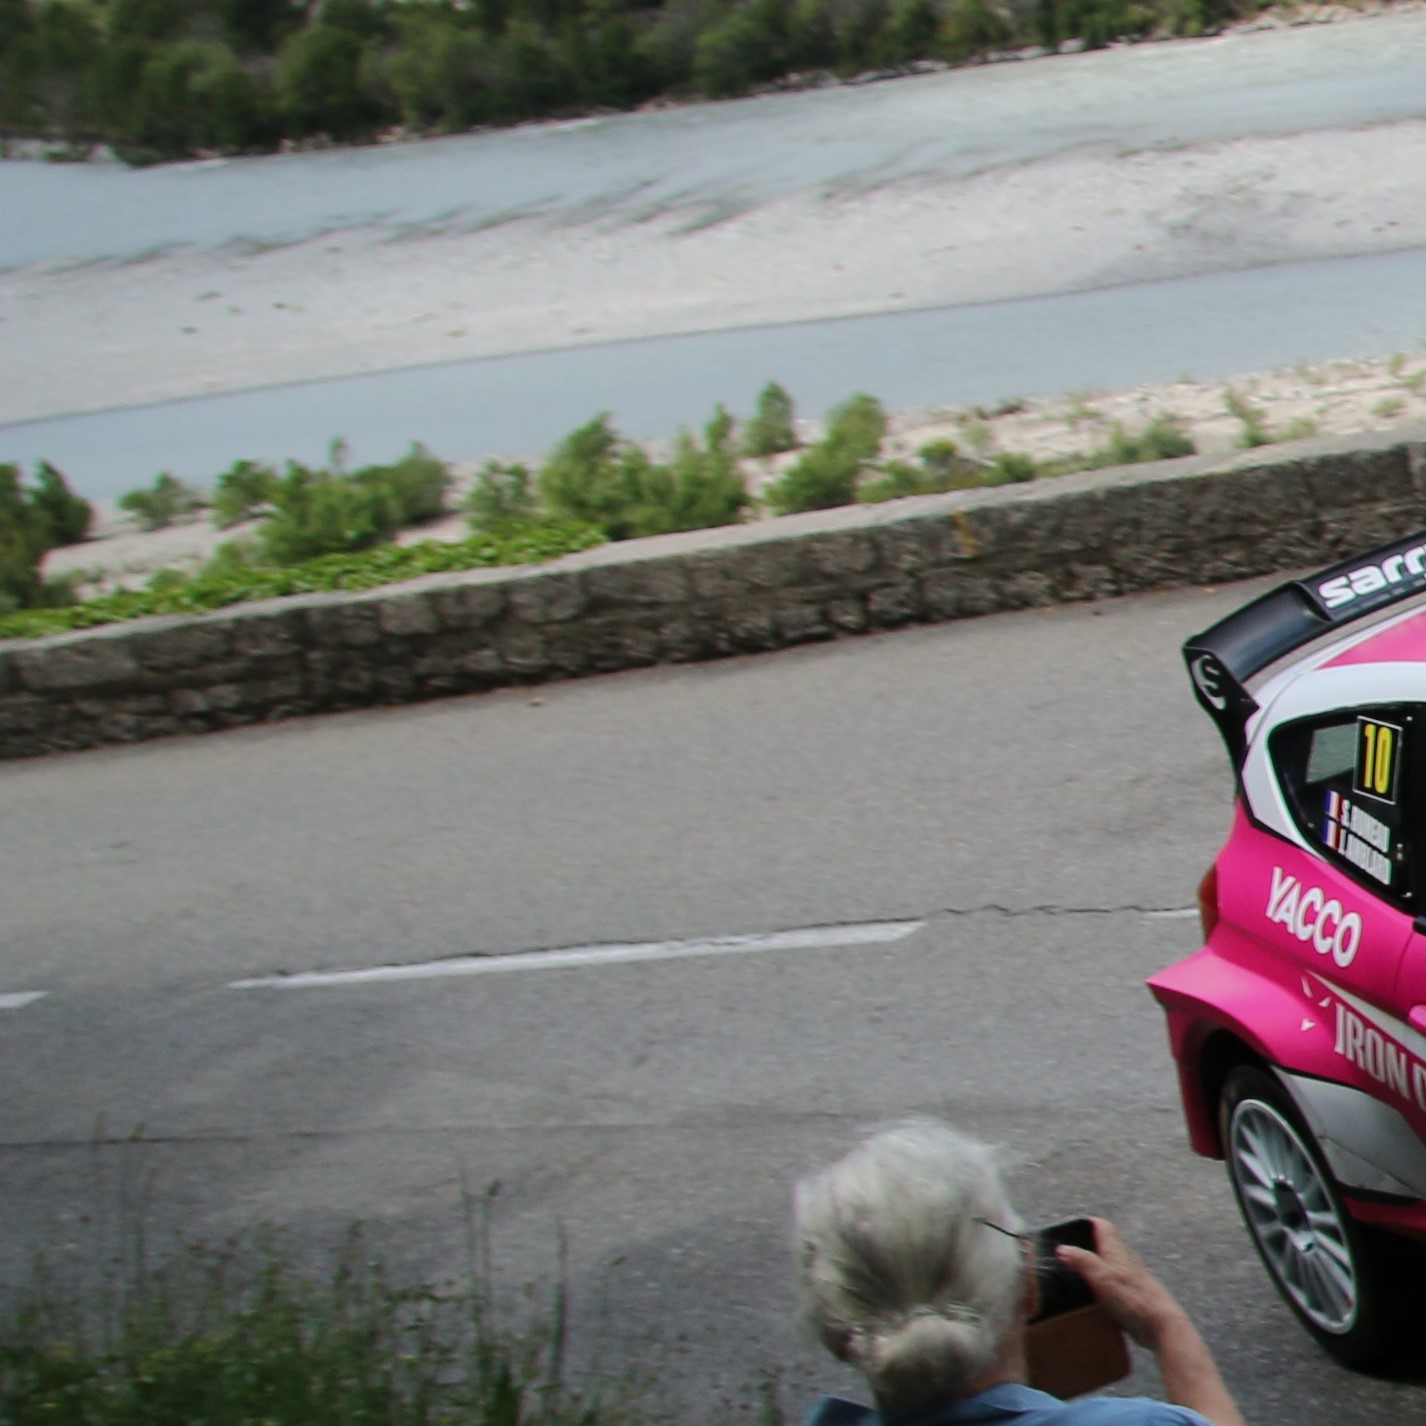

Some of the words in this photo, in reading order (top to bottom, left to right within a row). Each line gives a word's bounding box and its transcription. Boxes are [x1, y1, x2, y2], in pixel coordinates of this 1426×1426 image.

[1364, 723, 1393, 794] 10
[1265, 865, 1363, 968] YACCO
[1334, 1001, 1412, 1101] IRON
